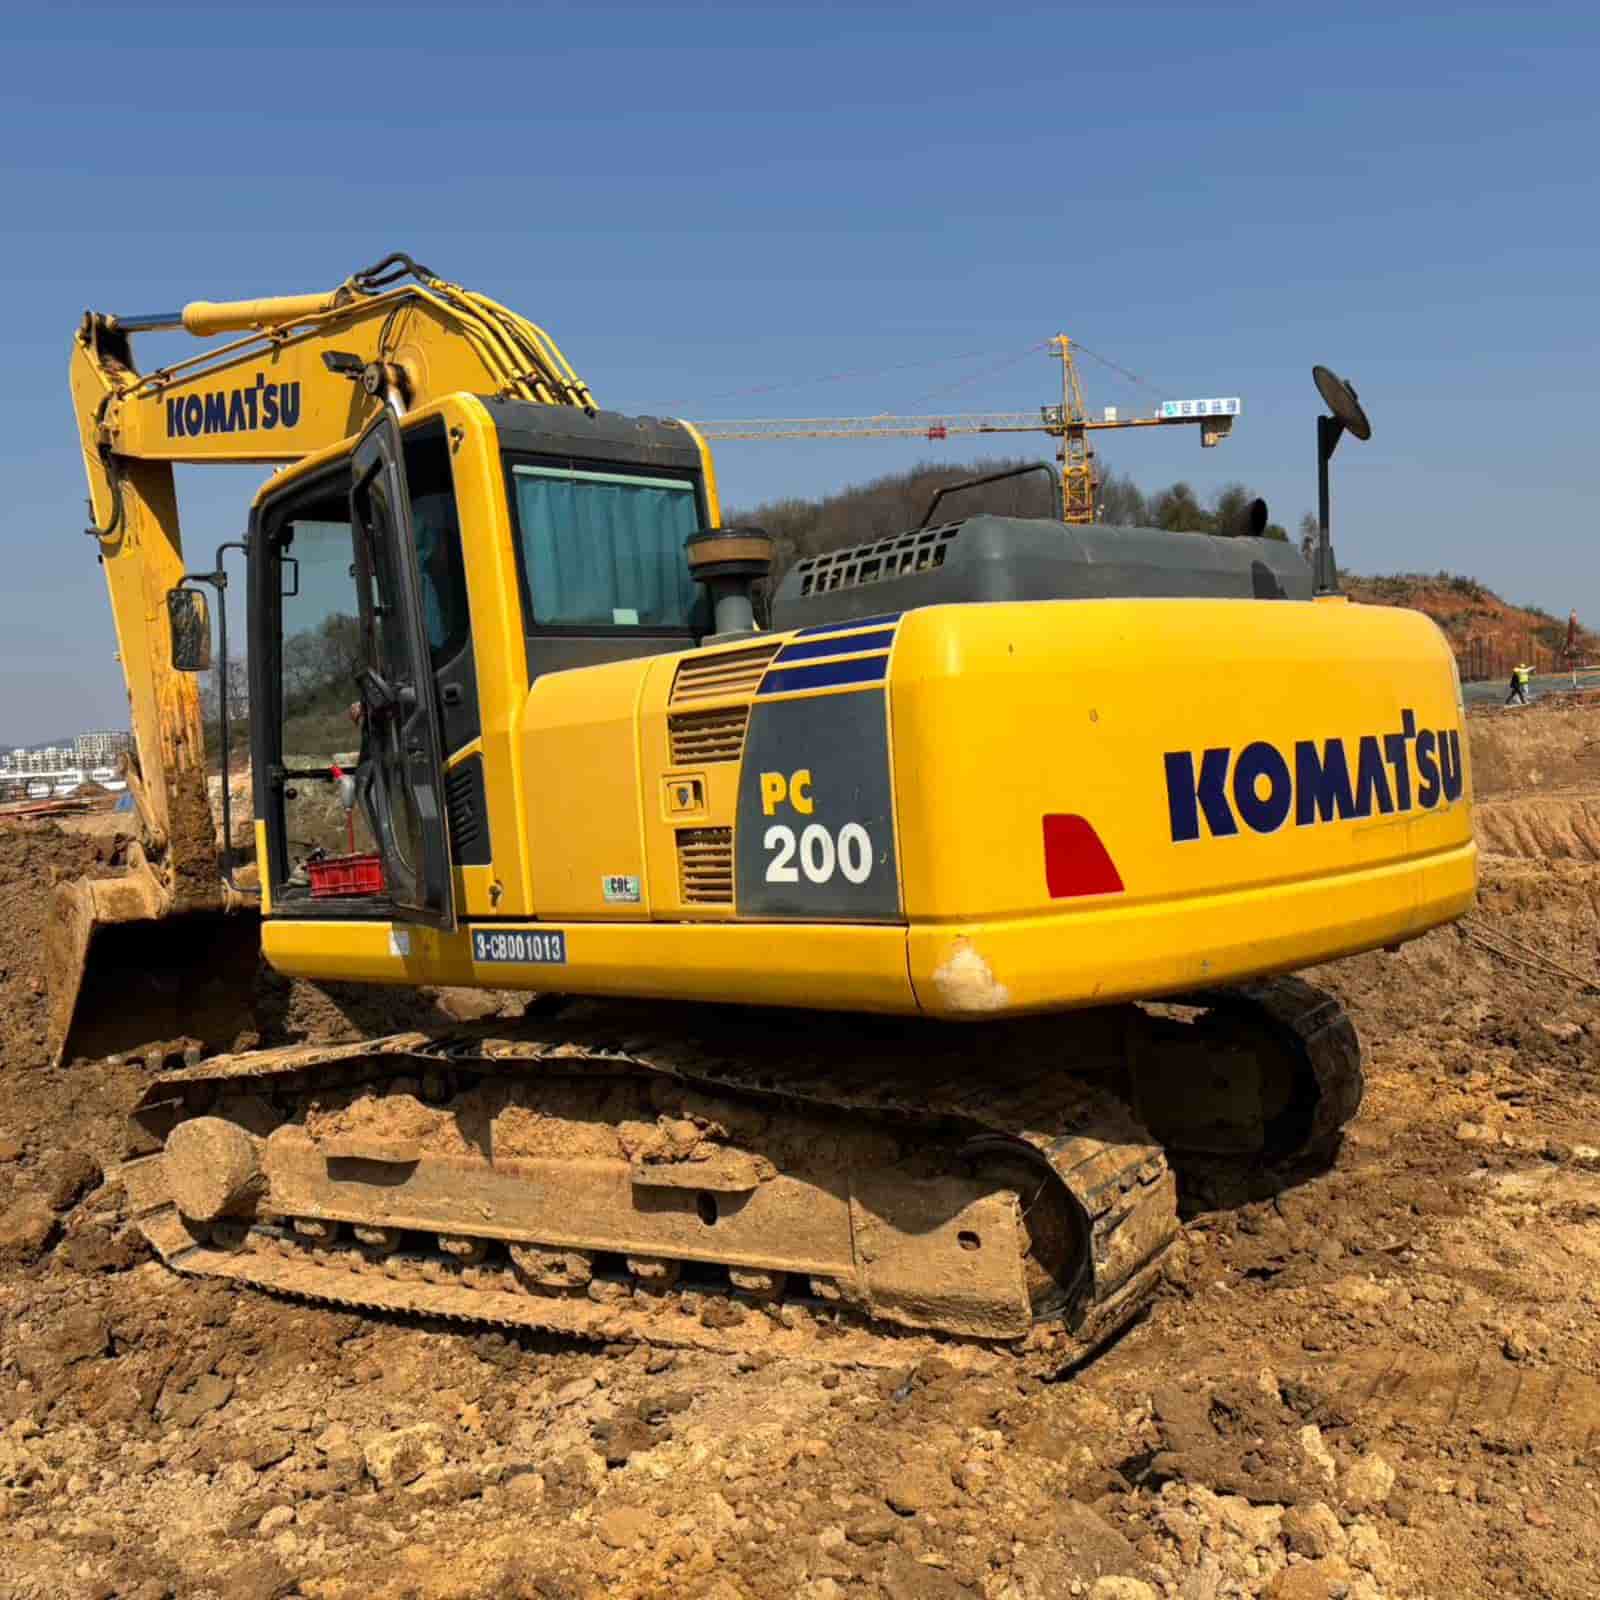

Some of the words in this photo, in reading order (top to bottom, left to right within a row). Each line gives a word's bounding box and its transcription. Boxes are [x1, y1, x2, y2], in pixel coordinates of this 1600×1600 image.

[166, 372, 300, 438] KOMATSU
[760, 768, 814, 816] PC
[1163, 708, 1463, 843] KOMATSU
[763, 821, 873, 884] 200
